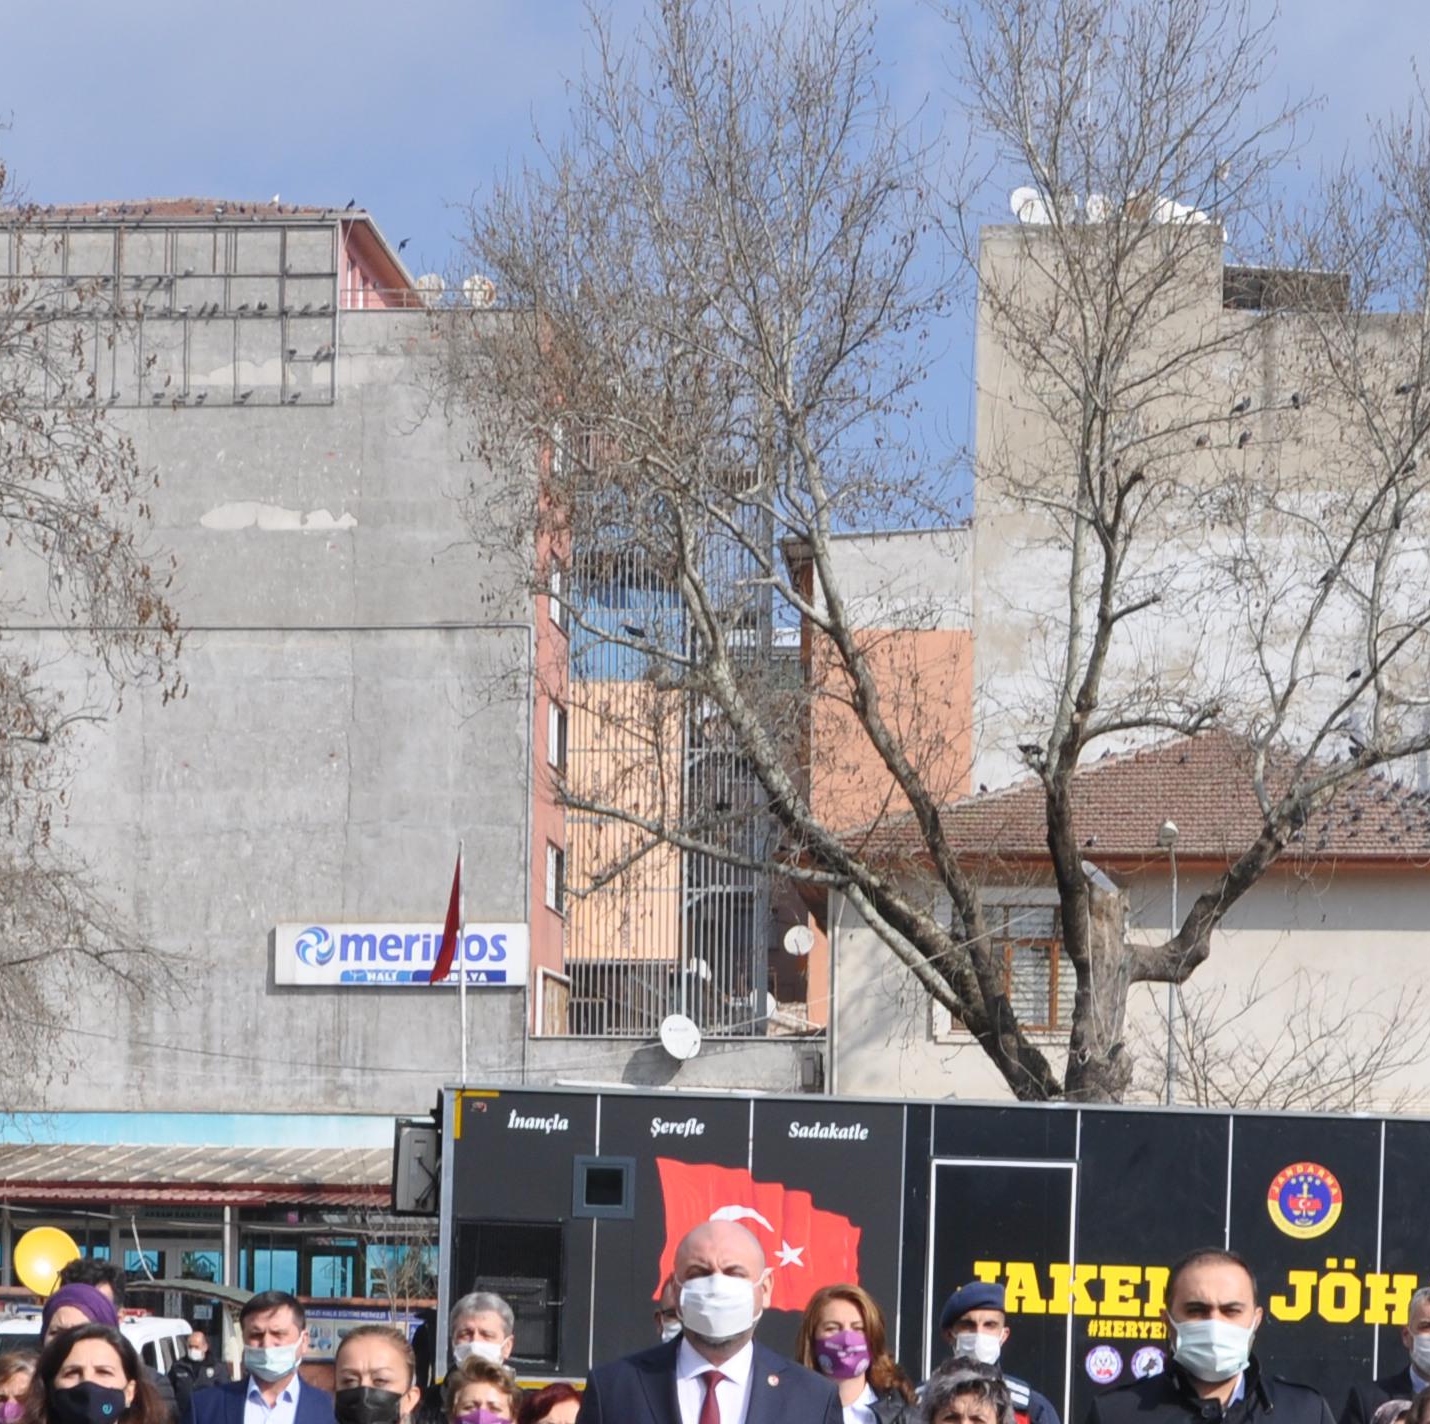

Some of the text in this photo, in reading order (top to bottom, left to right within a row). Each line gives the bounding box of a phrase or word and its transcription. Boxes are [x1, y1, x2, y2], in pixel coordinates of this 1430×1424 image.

[507, 1109, 569, 1135] İnançla
[650, 1117, 705, 1138] Şerefle
[788, 1121, 870, 1141] Sadakatle
